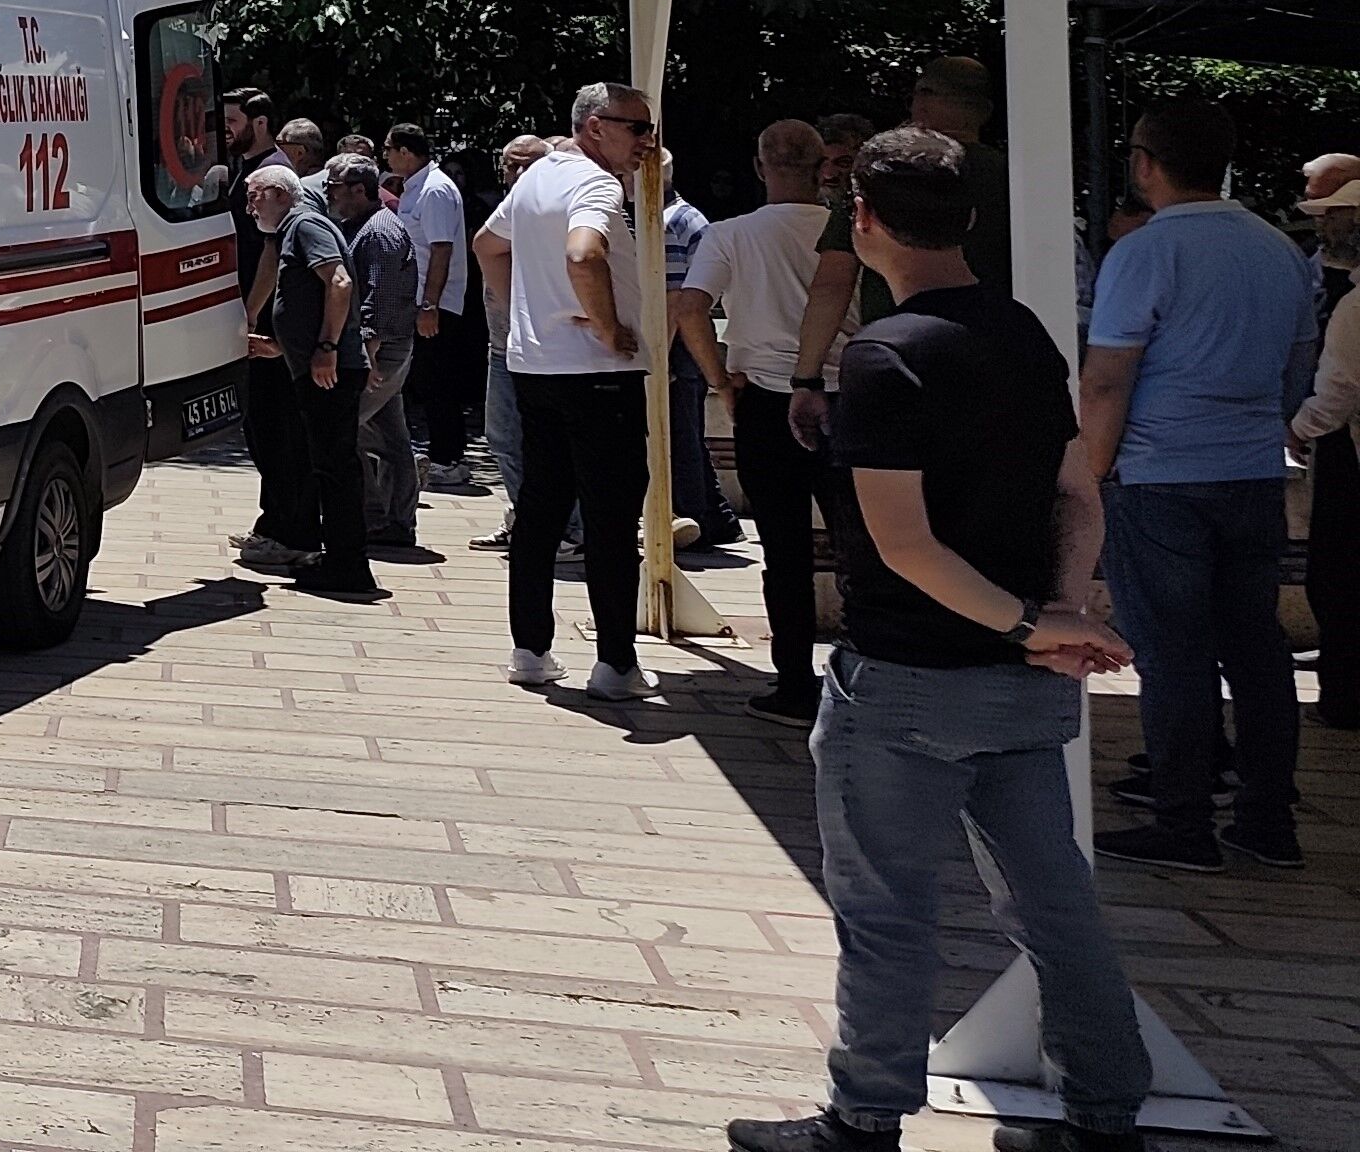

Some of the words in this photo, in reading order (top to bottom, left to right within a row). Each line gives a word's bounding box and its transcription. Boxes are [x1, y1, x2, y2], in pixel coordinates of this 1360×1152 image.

[18, 16, 47, 64] T.C.
[28, 65, 89, 122] BAKANLIĞI
[19, 132, 71, 213] 112
[188, 402, 200, 425] 45
[203, 396, 217, 420] FJ
